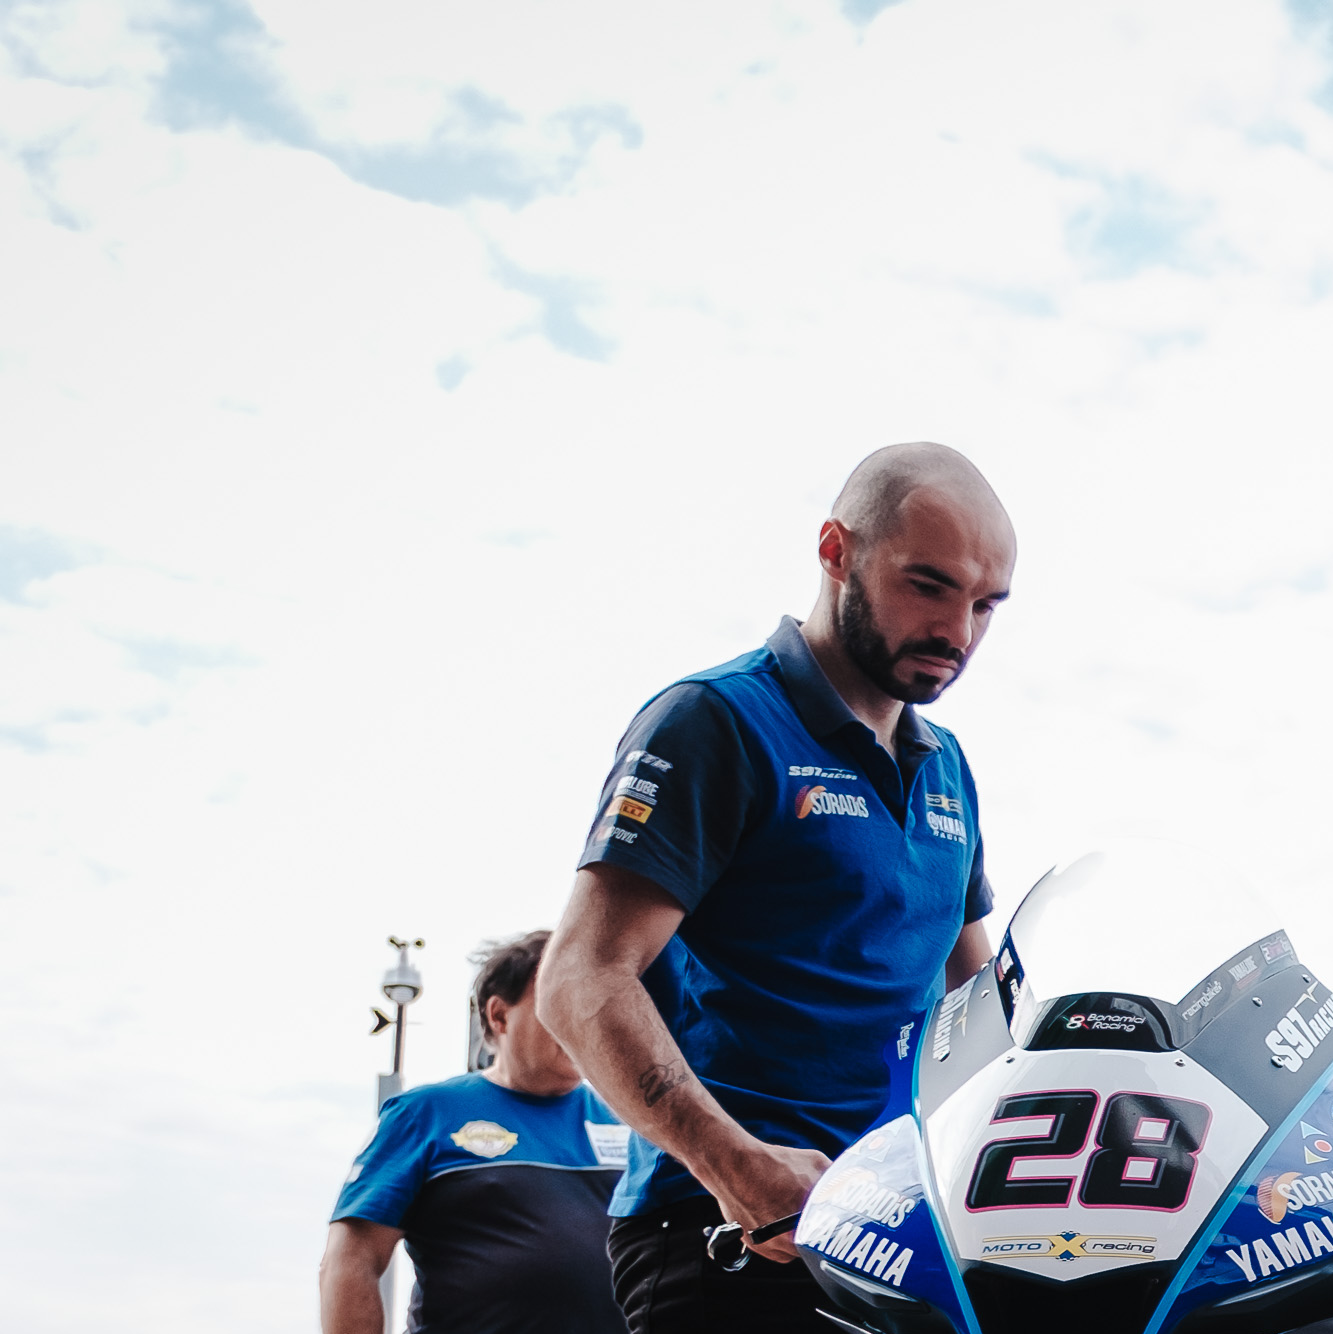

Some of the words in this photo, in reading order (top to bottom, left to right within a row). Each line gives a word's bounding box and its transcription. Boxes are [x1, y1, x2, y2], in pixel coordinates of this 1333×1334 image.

[1087, 1013, 1146, 1025] Bonamici
[1092, 1021, 1137, 1033] Racing
[965, 1088, 1214, 1214] 28
[982, 1242, 1042, 1254] MOTO
[1091, 1241, 1156, 1254] racing
